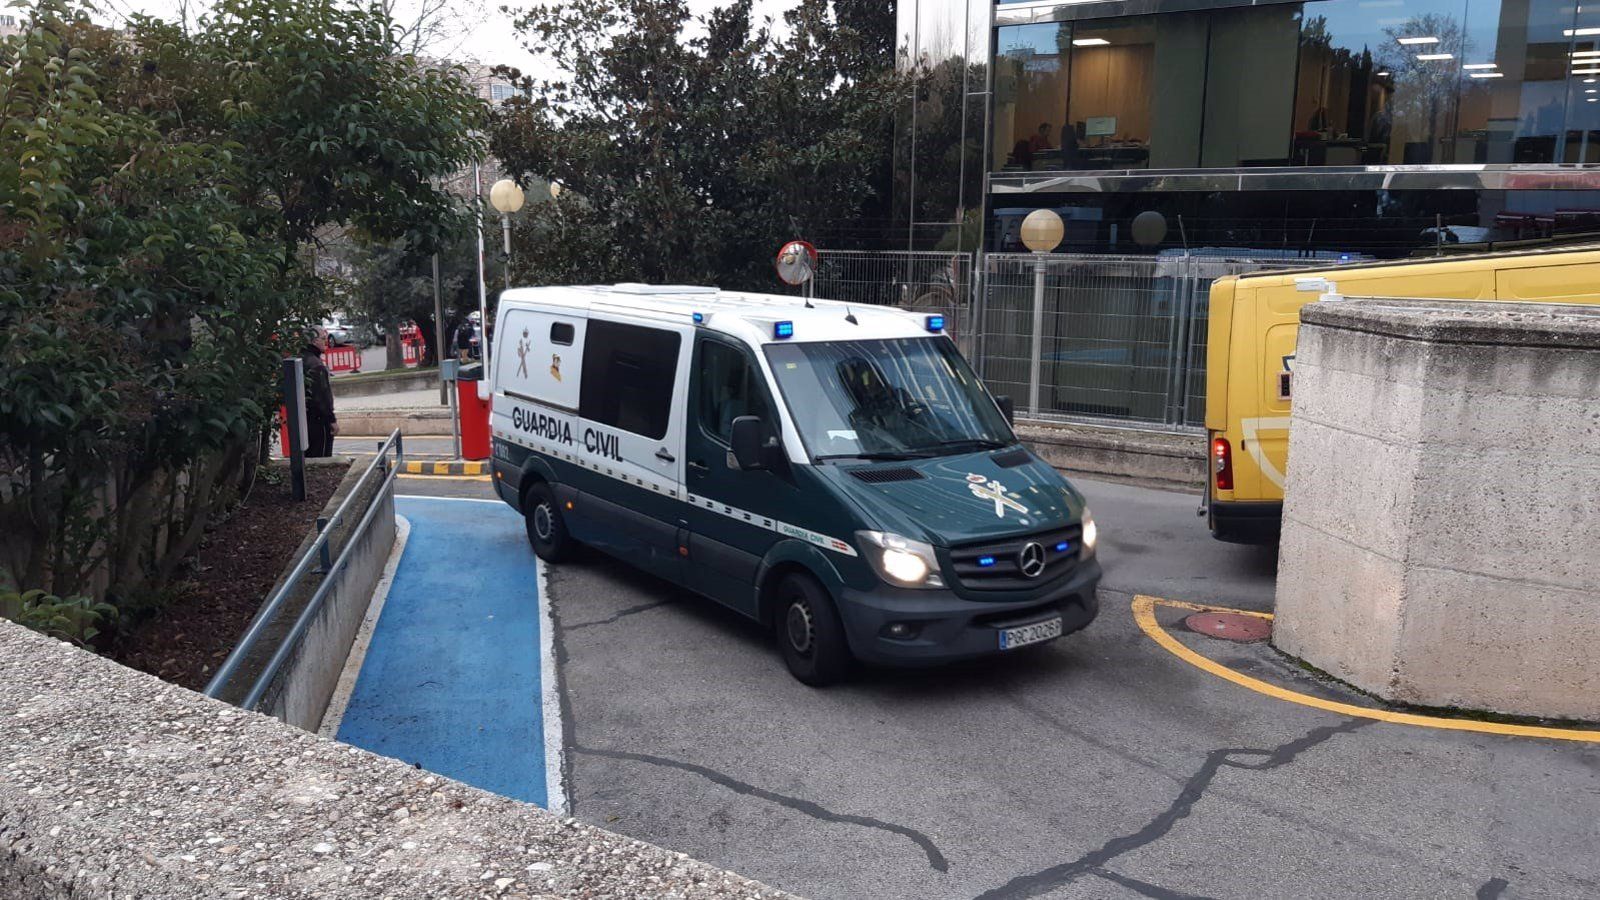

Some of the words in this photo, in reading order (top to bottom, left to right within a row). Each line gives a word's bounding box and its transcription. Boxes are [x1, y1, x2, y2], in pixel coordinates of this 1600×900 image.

[512, 408, 573, 446] GUARDIA
[585, 428, 624, 462] CIVIL
[784, 525, 808, 539] GUARDIA
[810, 533, 824, 545] CIVIL
